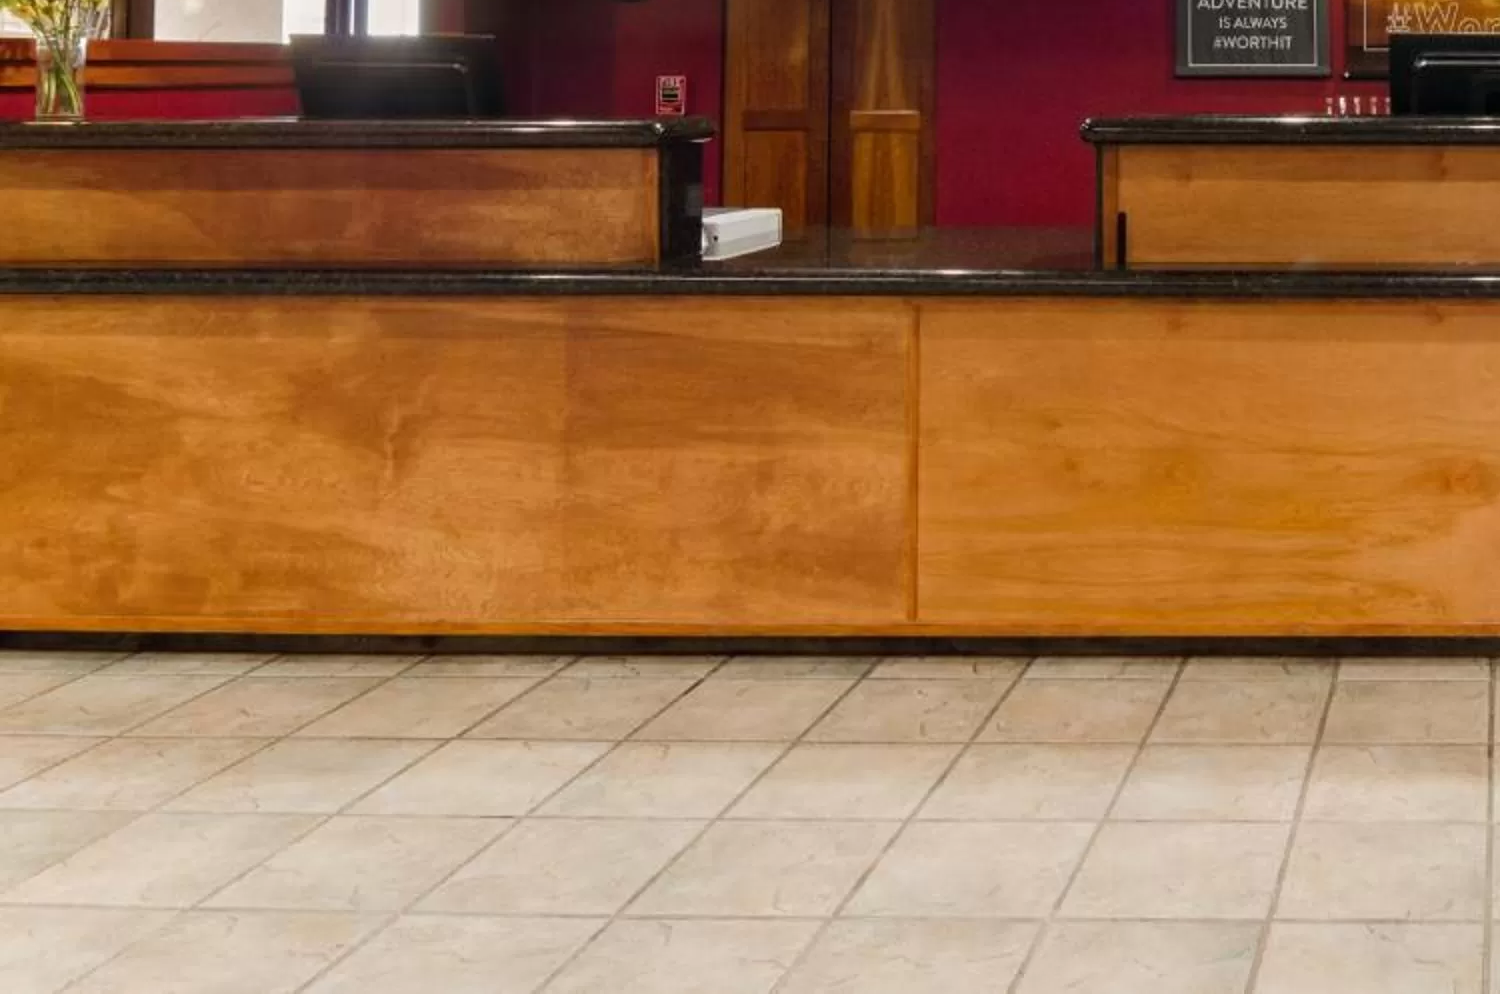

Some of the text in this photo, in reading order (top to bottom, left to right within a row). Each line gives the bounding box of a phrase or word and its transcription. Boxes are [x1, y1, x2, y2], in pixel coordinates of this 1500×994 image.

[1219, 17, 1288, 29] IS ALWAYS
[1213, 35, 1292, 49] #WORTHIT
